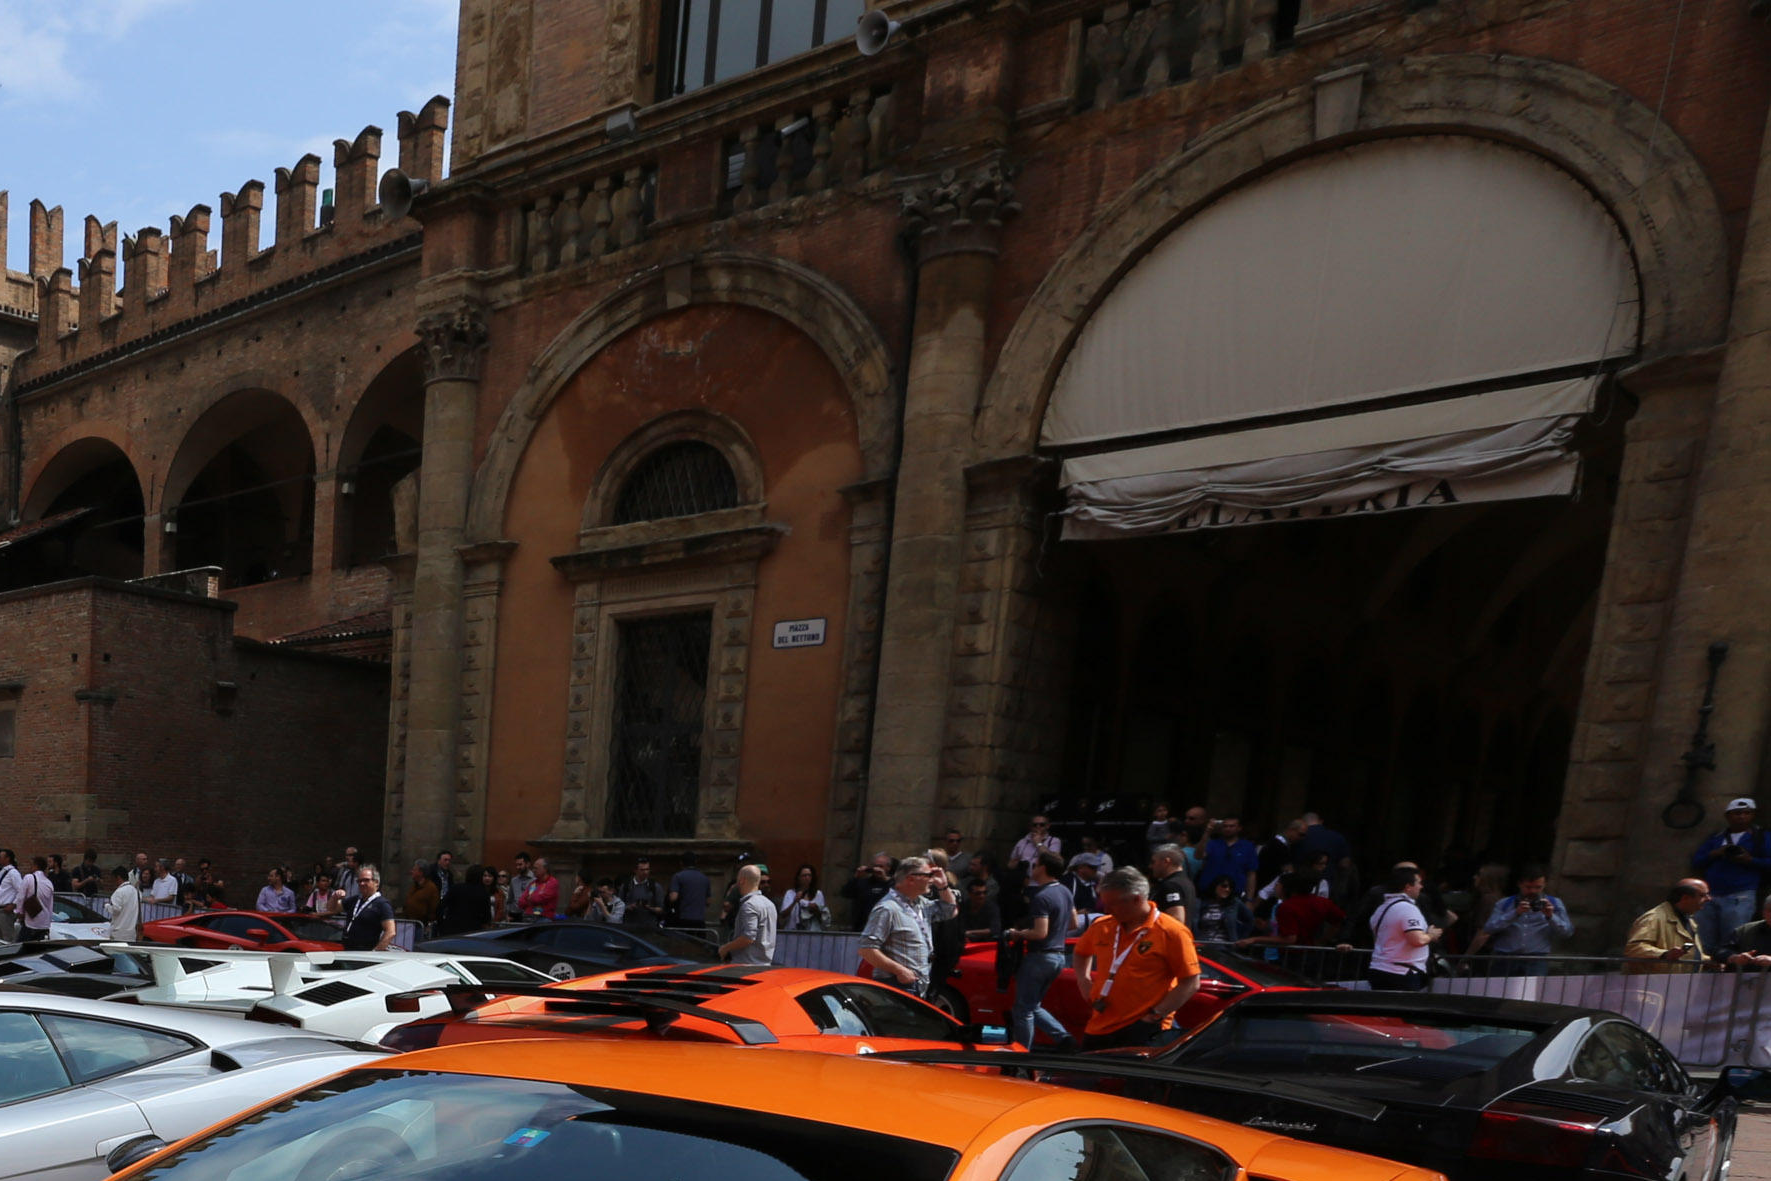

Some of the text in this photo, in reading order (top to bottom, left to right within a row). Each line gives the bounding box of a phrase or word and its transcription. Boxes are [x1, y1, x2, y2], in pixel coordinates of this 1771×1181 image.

[788, 623, 809, 632] PIAZZA
[777, 633, 820, 644] DEL NETTUNO
